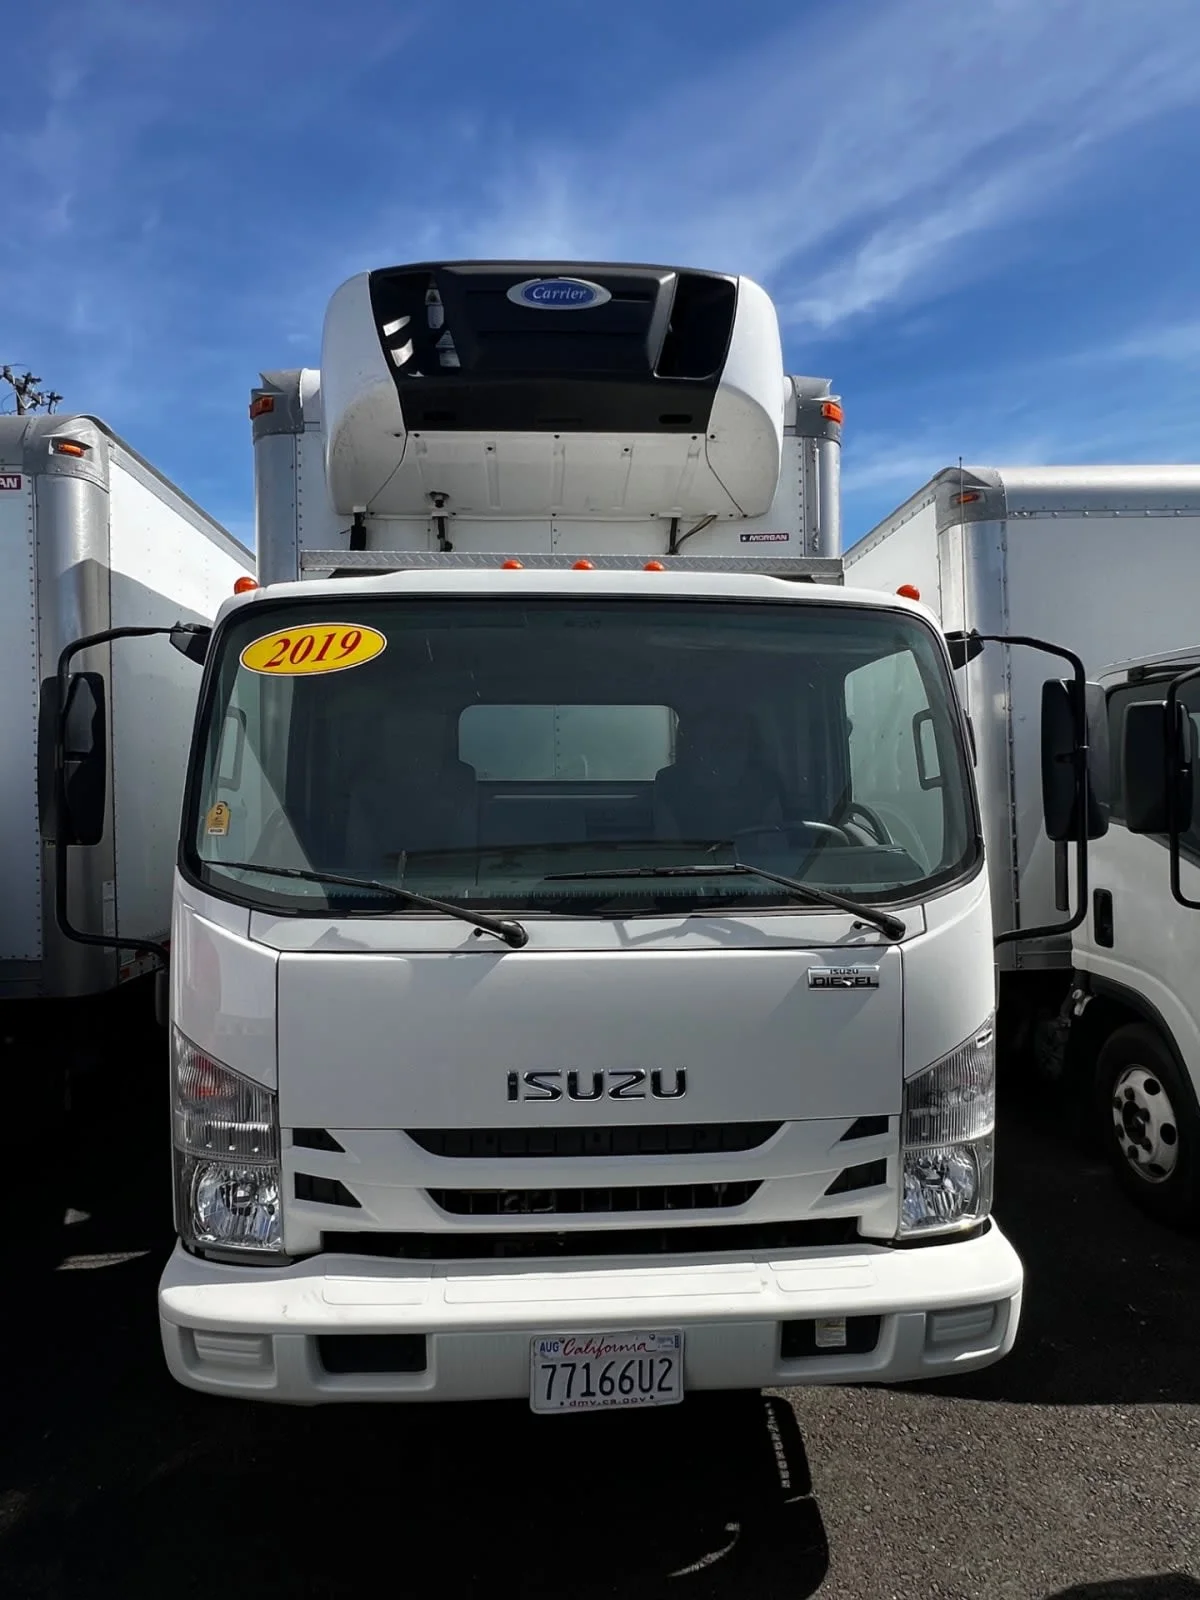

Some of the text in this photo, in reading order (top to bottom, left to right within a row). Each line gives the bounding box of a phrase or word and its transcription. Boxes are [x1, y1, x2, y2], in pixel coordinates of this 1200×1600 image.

[532, 286, 586, 300] Carrier
[262, 630, 362, 668] 2019
[215, 804, 224, 815] 5
[812, 976, 879, 988] DIESEL
[507, 1066, 687, 1102] ISUZU
[539, 1339, 560, 1353] AUG
[562, 1336, 657, 1359] California
[541, 1358, 673, 1400] 77166U2
[569, 1396, 646, 1408] dmv.ca.gov
